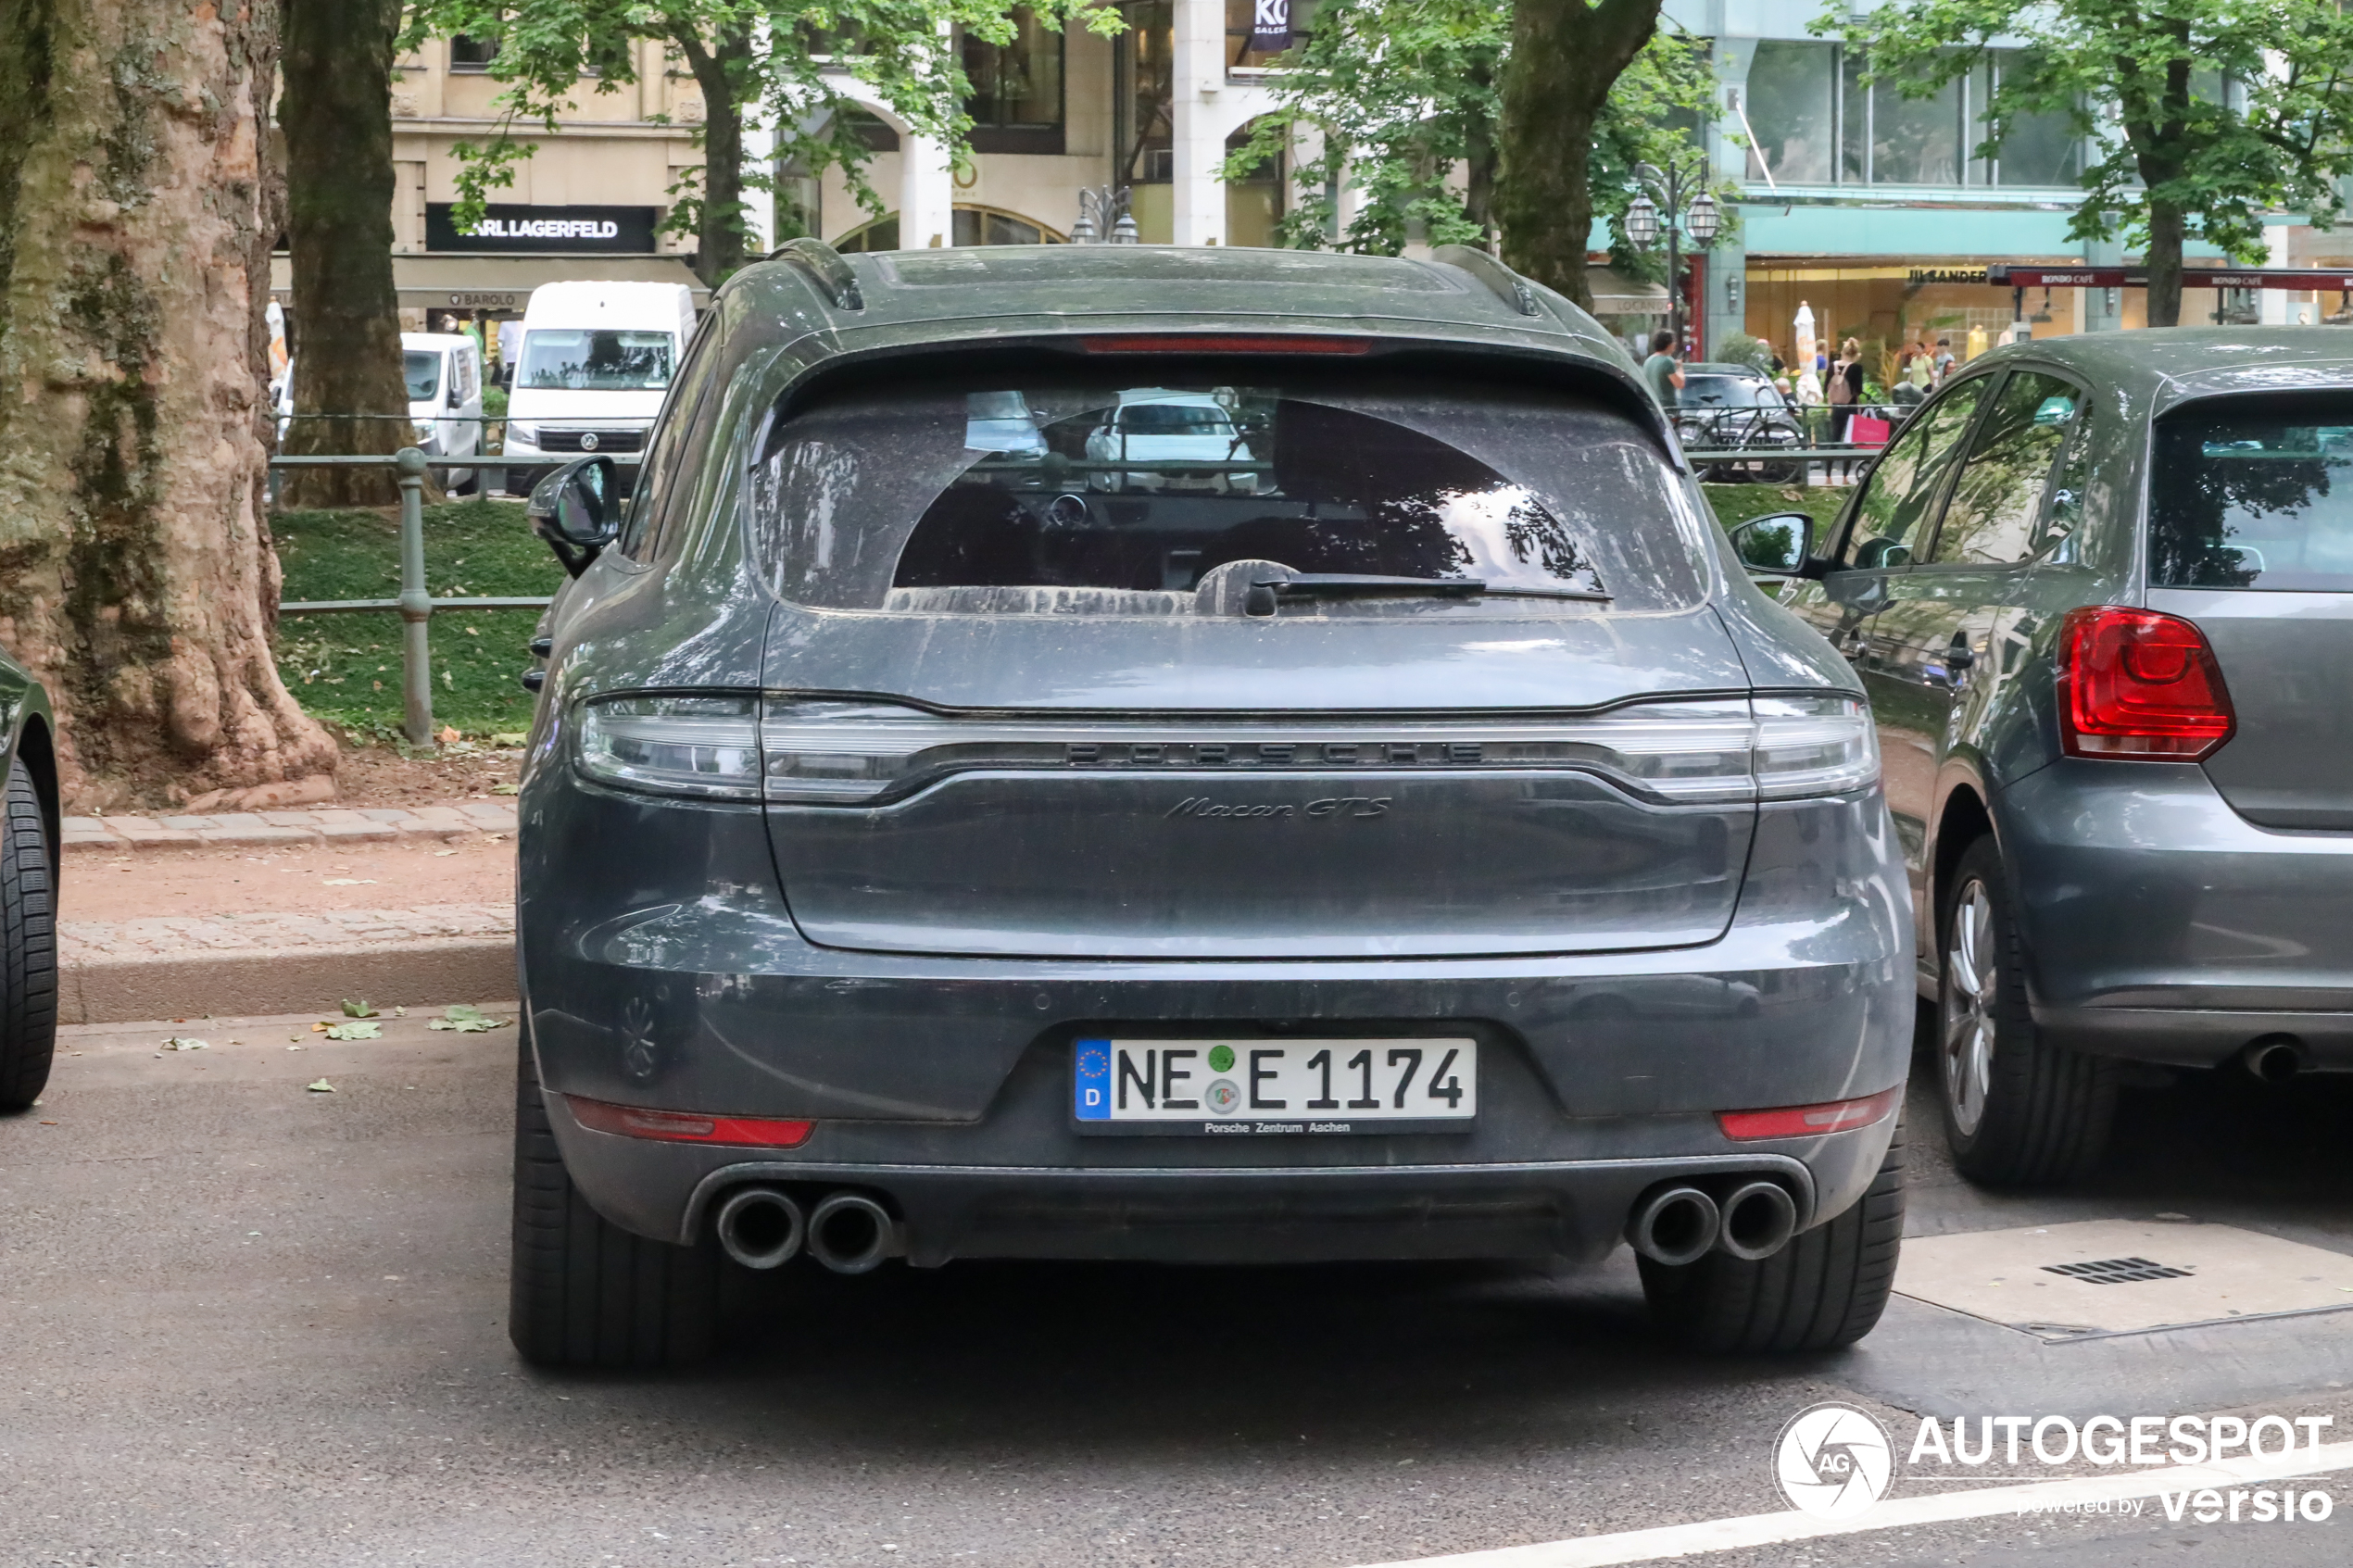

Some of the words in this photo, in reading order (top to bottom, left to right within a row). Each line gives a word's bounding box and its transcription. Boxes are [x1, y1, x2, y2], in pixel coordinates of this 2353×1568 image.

[509, 219, 618, 238] LAGERFELD
[464, 294, 516, 306] BAROLO
[1617, 300, 1670, 311] LOCAND
[1065, 742, 1482, 764] PORSCHE
[1164, 797, 1295, 818] Macan
[1303, 797, 1392, 817] GTS
[1117, 1048, 1200, 1110] NE
[1085, 1088, 1101, 1107] D
[1204, 1122, 1250, 1134] Porsche
[1256, 1122, 1303, 1134] Zentrum
[1308, 1122, 1351, 1134] Aachen
